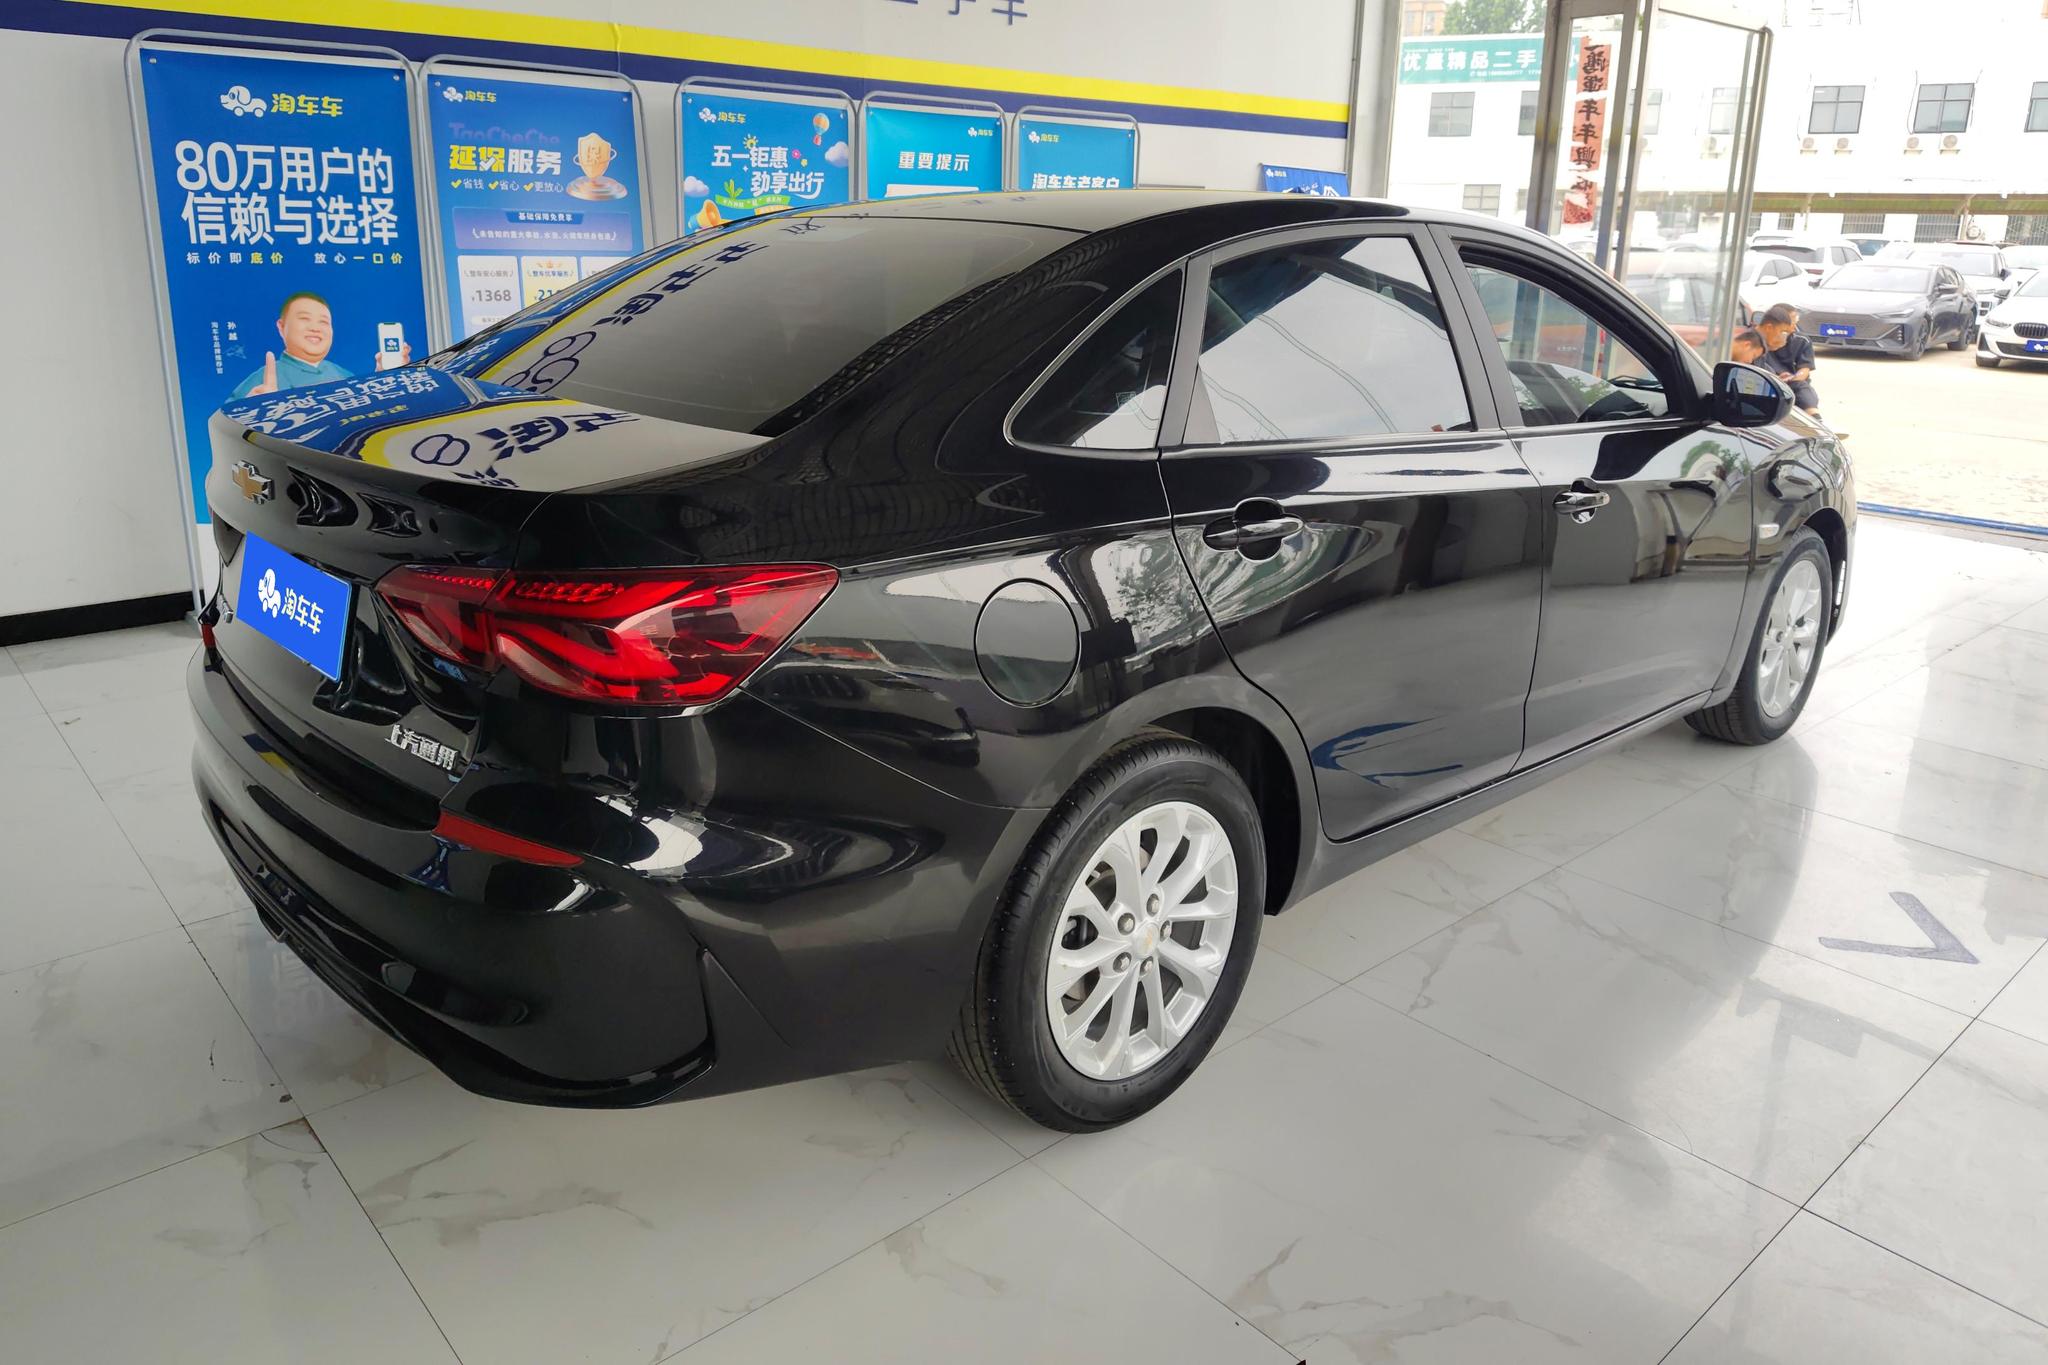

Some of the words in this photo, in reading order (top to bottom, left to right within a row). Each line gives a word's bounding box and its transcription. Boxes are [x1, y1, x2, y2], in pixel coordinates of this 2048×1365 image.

[270, 93, 344, 118] 淘车车
[464, 90, 497, 103] 淘车车
[717, 111, 747, 124] 淘车车
[174, 139, 395, 195] 80万用户的
[449, 144, 562, 176] 延保服务
[711, 145, 789, 168] 五一钜惠
[898, 151, 970, 172] 重要提示
[462, 178, 485, 191] 省钱
[499, 180, 520, 193] 省心
[534, 181, 564, 194] 更放心
[750, 170, 825, 199] 劲享出行
[1031, 173, 1120, 190] 淘车车老客户
[181, 191, 399, 246] 信赖与选择
[186, 252, 284, 265] 标价即底价
[314, 253, 403, 265] 放心一口价
[281, 587, 324, 635] 淘车车
[384, 724, 458, 771] 上汽通用
